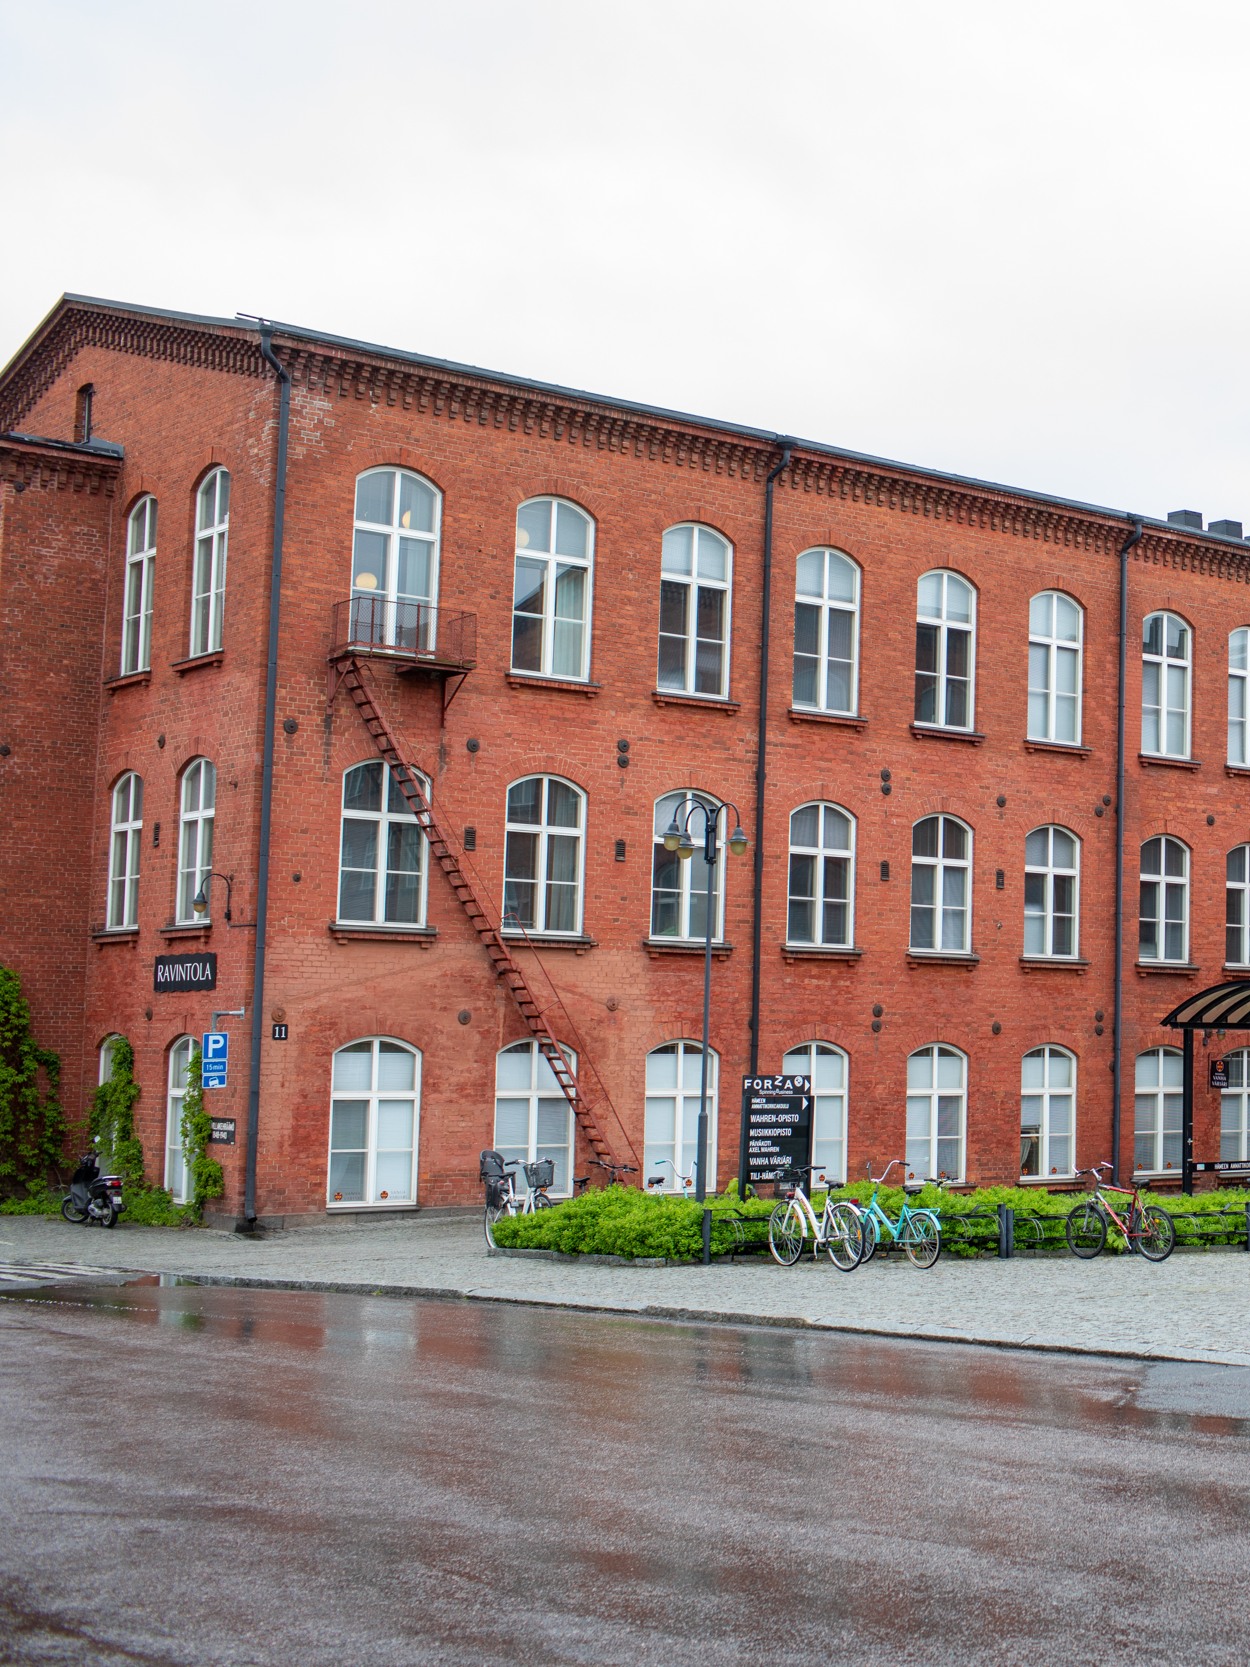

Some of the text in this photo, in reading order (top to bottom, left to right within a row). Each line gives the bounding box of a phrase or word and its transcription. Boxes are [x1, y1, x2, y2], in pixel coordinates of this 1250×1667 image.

[157, 962, 212, 983] RAVINTOLA
[274, 1026, 287, 1038] 11
[207, 1035, 225, 1058] P
[744, 1075, 793, 1089] FORZA
[750, 1114, 799, 1123] WAHREN-OPISTO
[749, 1128, 792, 1137] MUSIIKKIOPISTO
[749, 1155, 792, 1166] VANHA VÄRJÄRI
